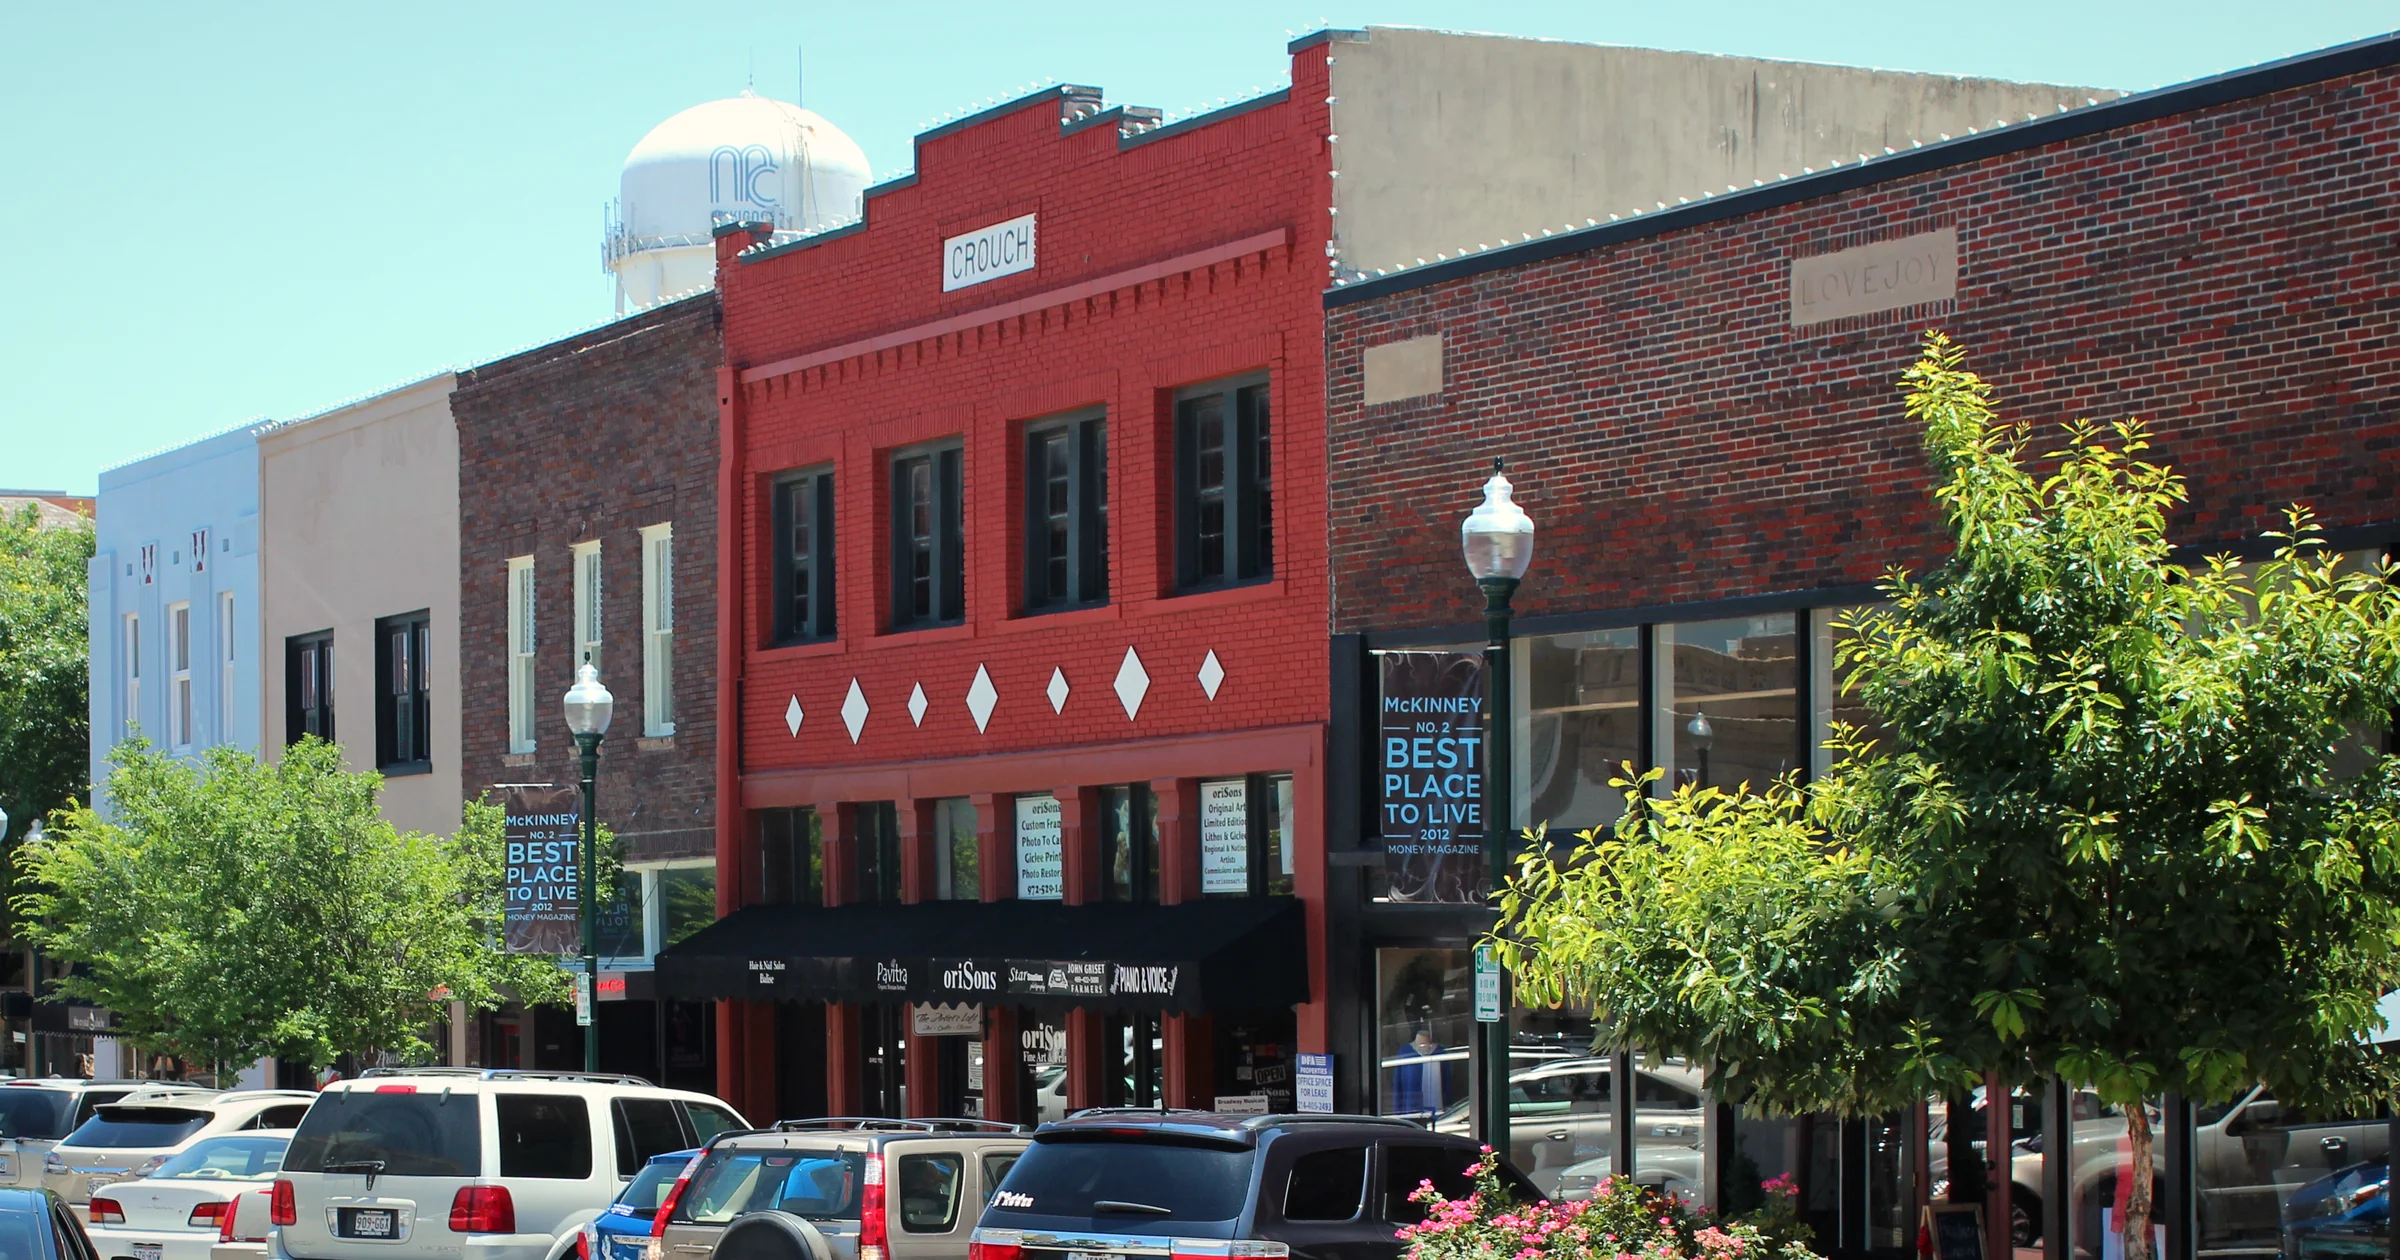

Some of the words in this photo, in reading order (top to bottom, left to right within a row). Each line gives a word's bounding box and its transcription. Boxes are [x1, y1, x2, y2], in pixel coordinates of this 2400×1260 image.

[952, 225, 1028, 279] CROUCH
[1802, 253, 1940, 306] LOVEJOY
[1384, 697, 1482, 713] McKINNEY
[1416, 722, 1438, 733] NO.
[1441, 722, 1450, 733] 2
[1386, 737, 1481, 769] BEST
[1212, 786, 1242, 799] oriSons
[1385, 774, 1481, 798] PLACE
[1208, 803, 1234, 816] Original
[1384, 803, 1420, 824] TO
[1428, 803, 1481, 824] LIVE
[506, 813, 579, 827] McKINNEY
[1021, 820, 1046, 831] Custom
[1203, 817, 1226, 828] Limited
[529, 831, 547, 840] NO.
[549, 830, 555, 840] 2
[1420, 829, 1450, 840] 2012
[1021, 836, 1041, 848] Photo
[1042, 835, 1050, 846] To
[508, 841, 577, 864] BEST
[1388, 844, 1425, 854] MONEY
[1428, 844, 1479, 854] MAGAZINE
[507, 866, 577, 884] PLACE
[1021, 869, 1040, 879] Photo
[506, 887, 533, 901] TO
[538, 886, 577, 900] LIVE
[531, 903, 553, 912] 2012
[507, 913, 535, 922] MONEY
[536, 913, 576, 921] MAGAZINE
[877, 961, 907, 985] Pavitra
[944, 960, 997, 990] oriSons
[1008, 967, 1028, 983] Star
[1067, 964, 1083, 974] JOHN
[1084, 964, 1105, 974] GRISET
[1120, 966, 1140, 993] PIANO
[1141, 967, 1147, 993] &
[1146, 966, 1168, 993] VOICE
[1070, 984, 1103, 994] FARMERS
[916, 1013, 930, 1023] The
[1023, 1051, 1036, 1063] Fine
[1036, 1051, 1047, 1062] Art
[1257, 1066, 1284, 1083] OPEN
[1300, 1067, 1327, 1075] PROPERTIES
[1297, 1077, 1314, 1087] OFFICE
[1314, 1078, 1331, 1087] SPACE
[1300, 1088, 1311, 1097] FOR
[1311, 1089, 1328, 1097] LEASE
